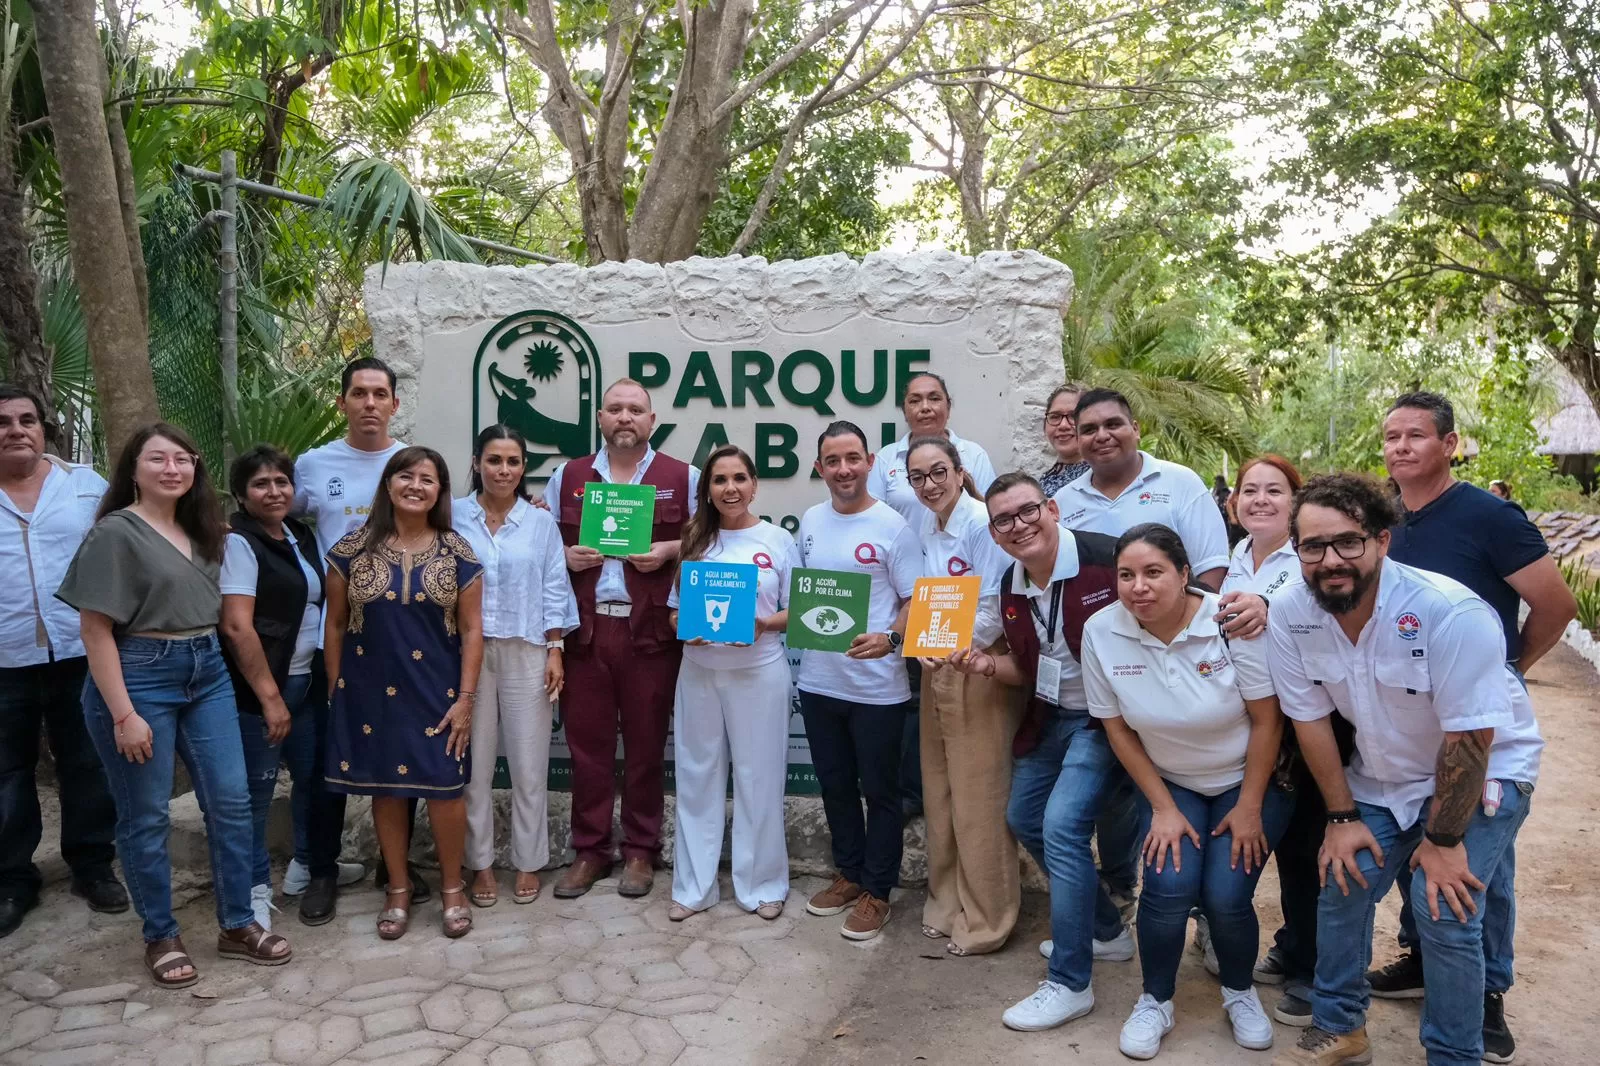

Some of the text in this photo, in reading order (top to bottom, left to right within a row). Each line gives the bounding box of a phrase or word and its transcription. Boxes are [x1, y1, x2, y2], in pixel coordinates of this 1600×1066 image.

[590, 490, 603, 504] 15
[344, 506, 352, 515] 5
[690, 570, 698, 586] 6
[704, 570, 738, 580] AGUA LIMPIA
[709, 580, 746, 588] SANEAMIENTO
[798, 577, 812, 593] 13
[816, 577, 836, 587] ACCIÓN
[815, 587, 826, 595] POR
[836, 588, 852, 597] CLIMA
[919, 586, 928, 602] 11
